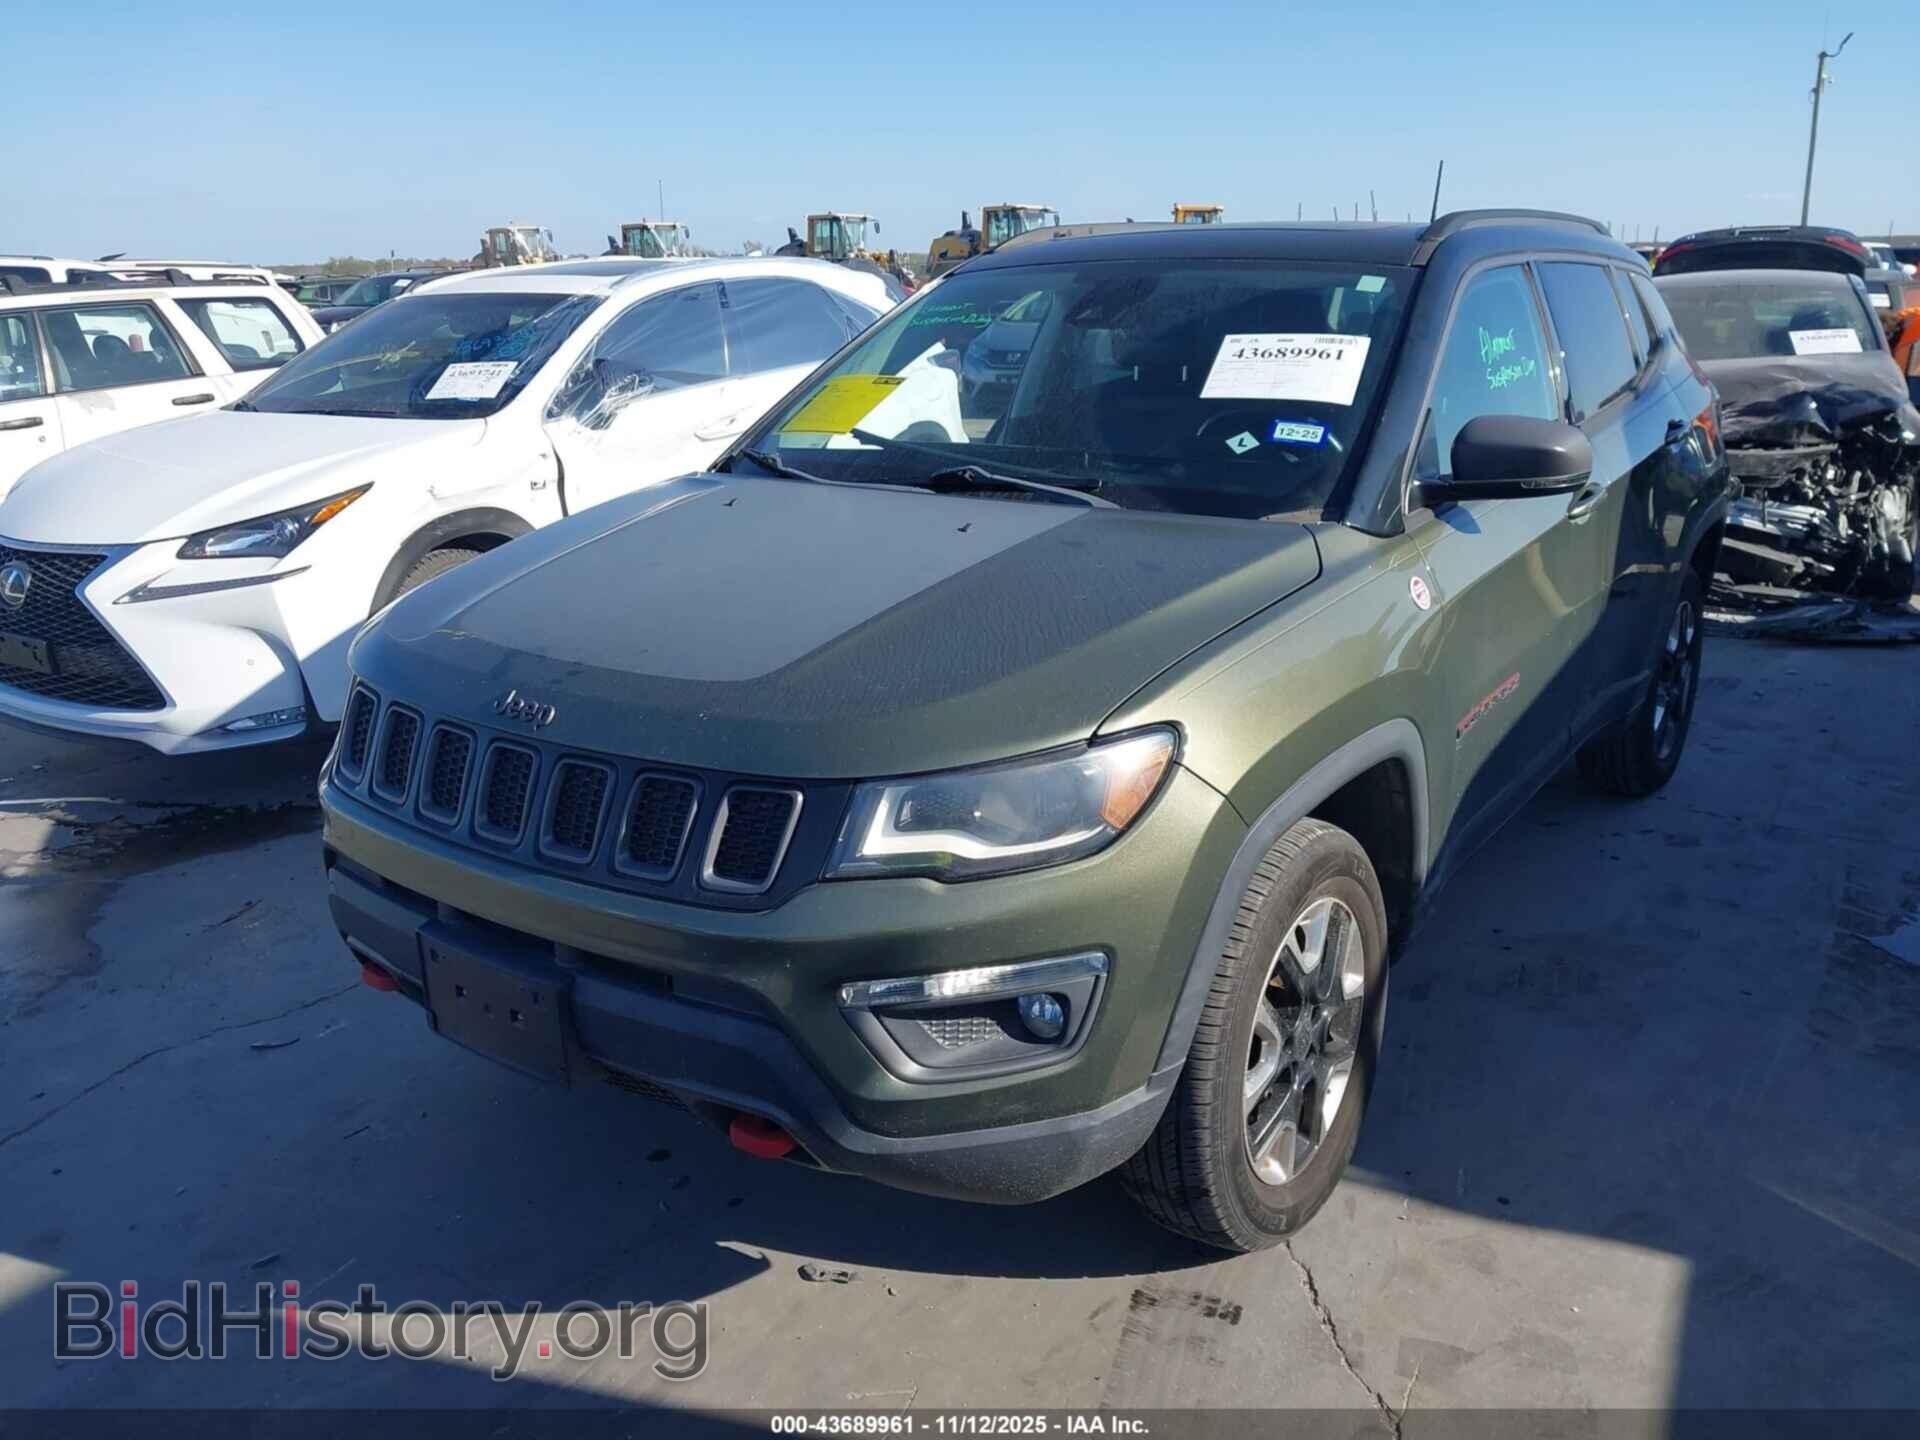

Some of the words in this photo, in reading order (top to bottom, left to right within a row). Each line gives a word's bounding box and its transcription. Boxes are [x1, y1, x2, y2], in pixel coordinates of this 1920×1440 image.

[1232, 347, 1344, 360] 43689961
[1279, 428, 1319, 439] 12-25
[493, 688, 557, 731] Jeep
